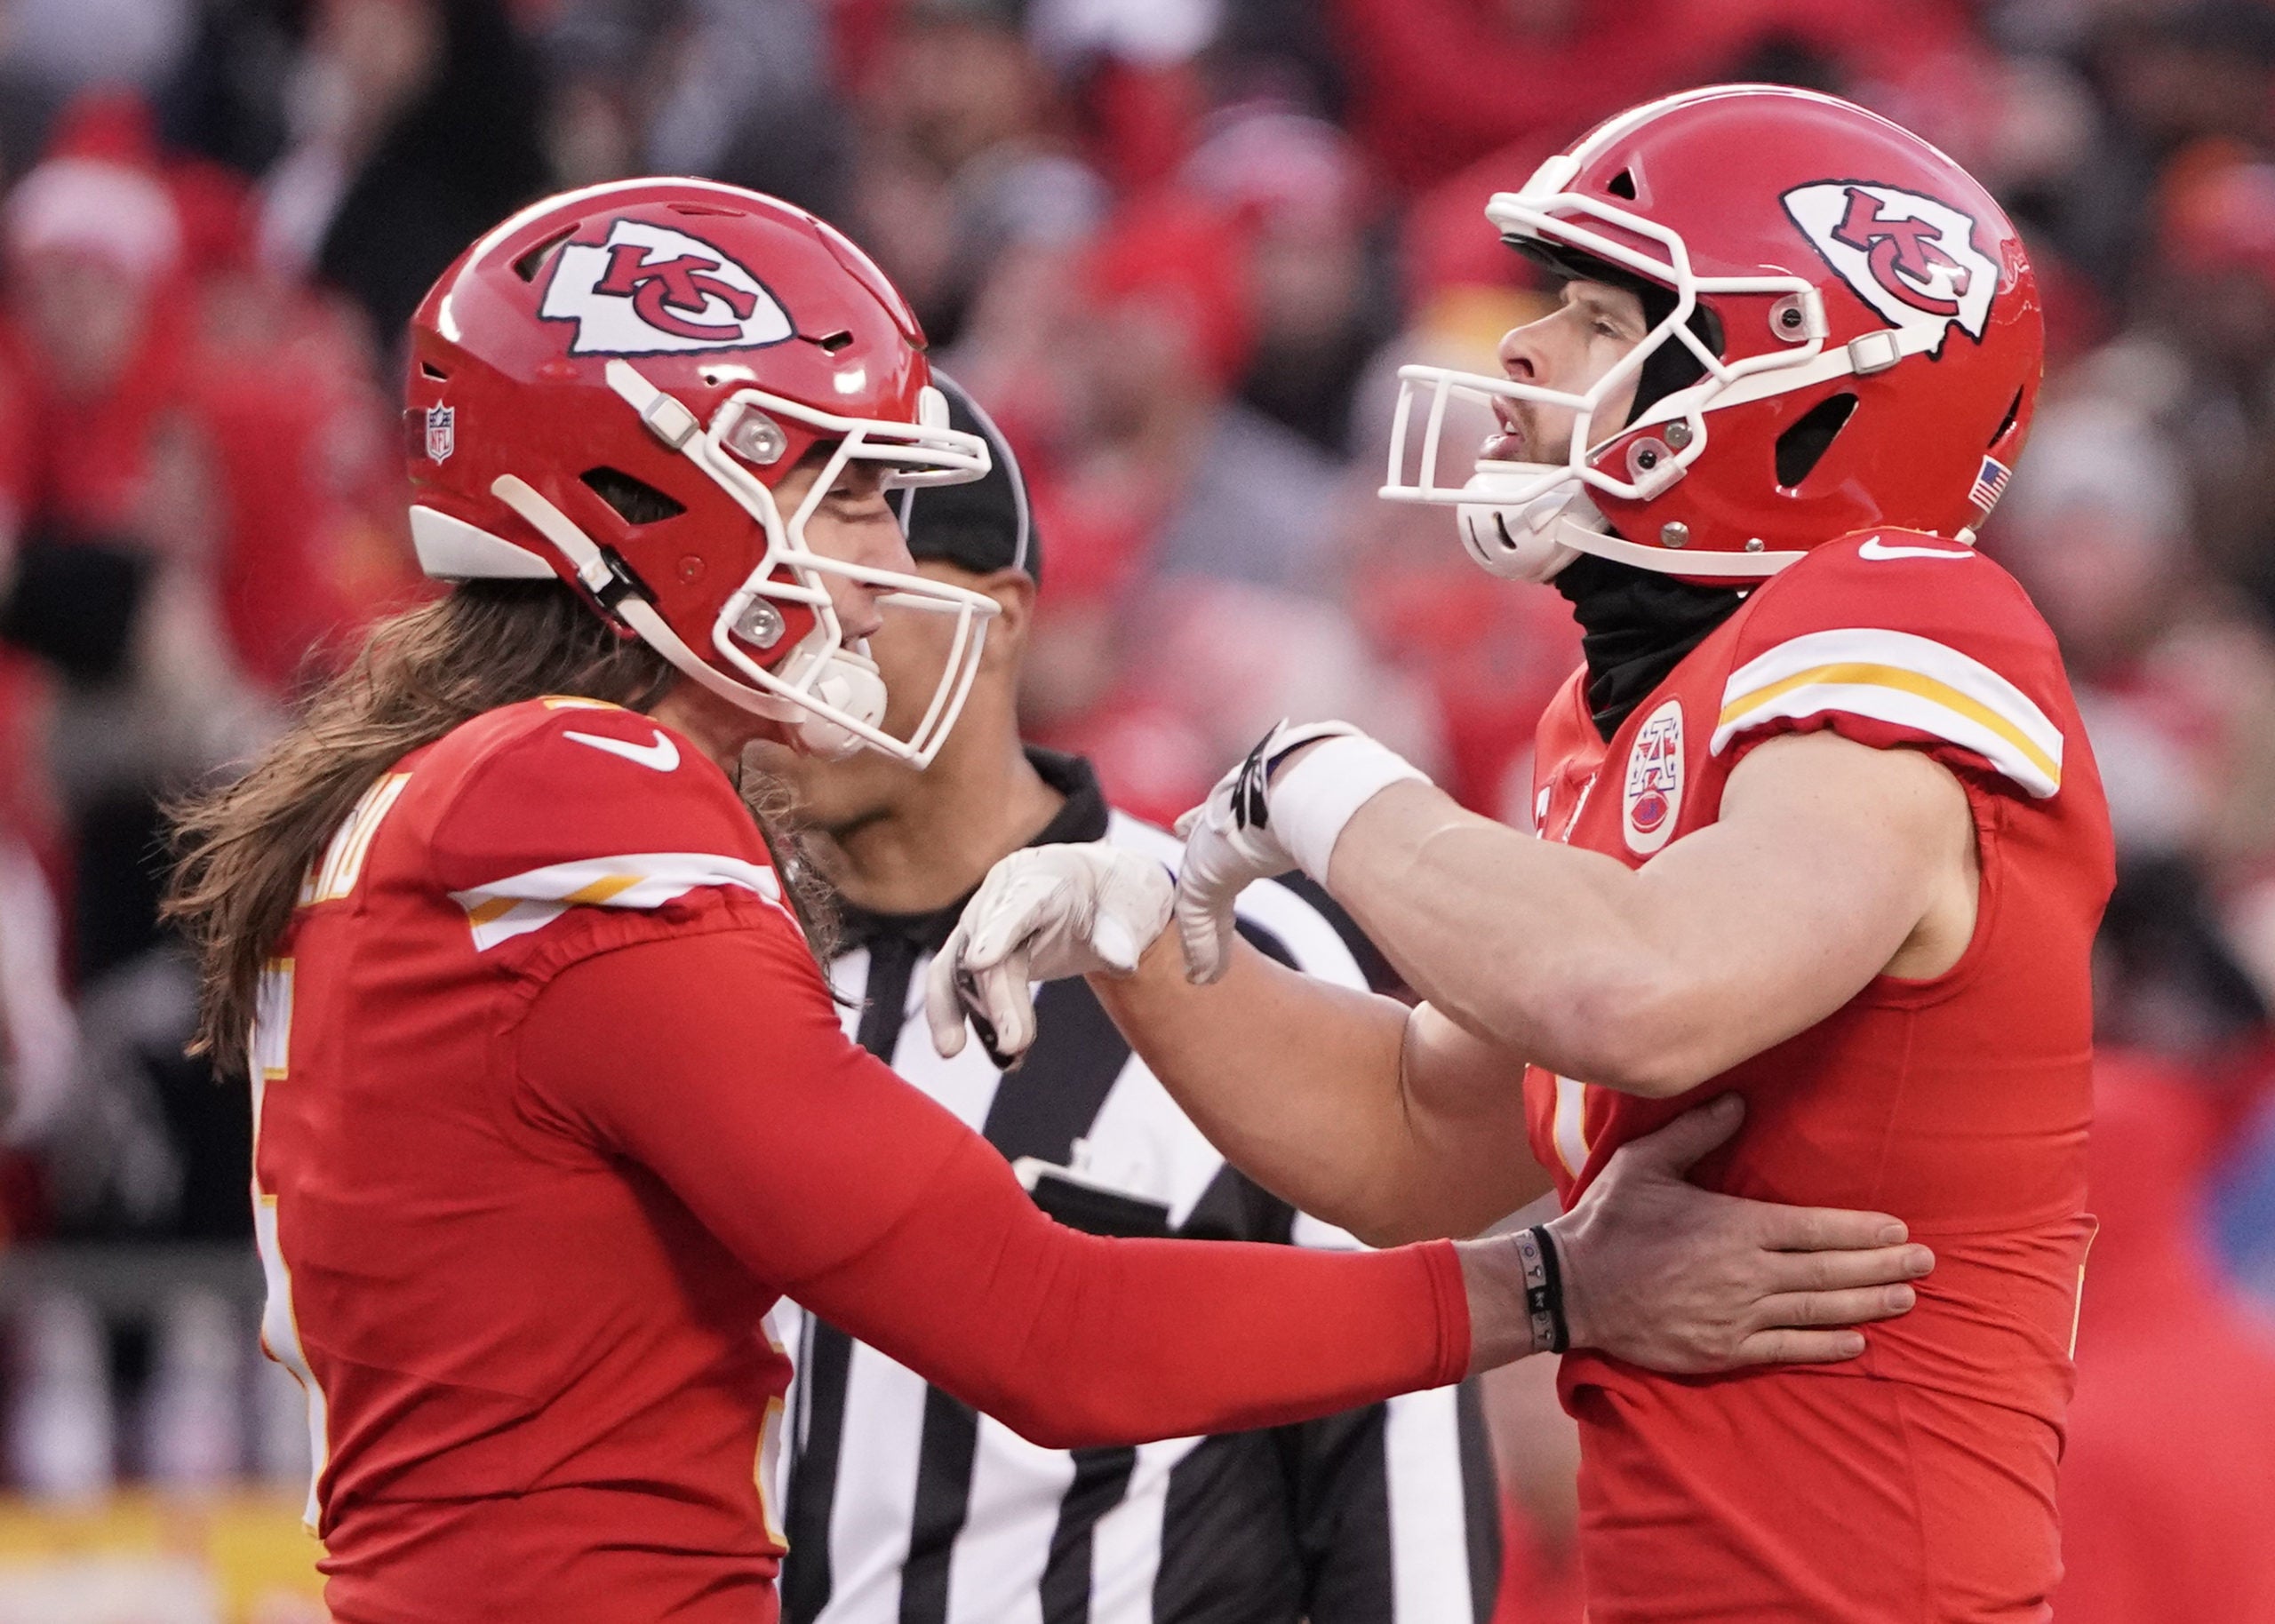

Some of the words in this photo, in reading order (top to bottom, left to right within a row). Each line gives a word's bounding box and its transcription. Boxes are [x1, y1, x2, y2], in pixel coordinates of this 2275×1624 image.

[591, 243, 758, 341] KC
[1830, 187, 1972, 317] KC
[430, 429, 450, 453] NFL
